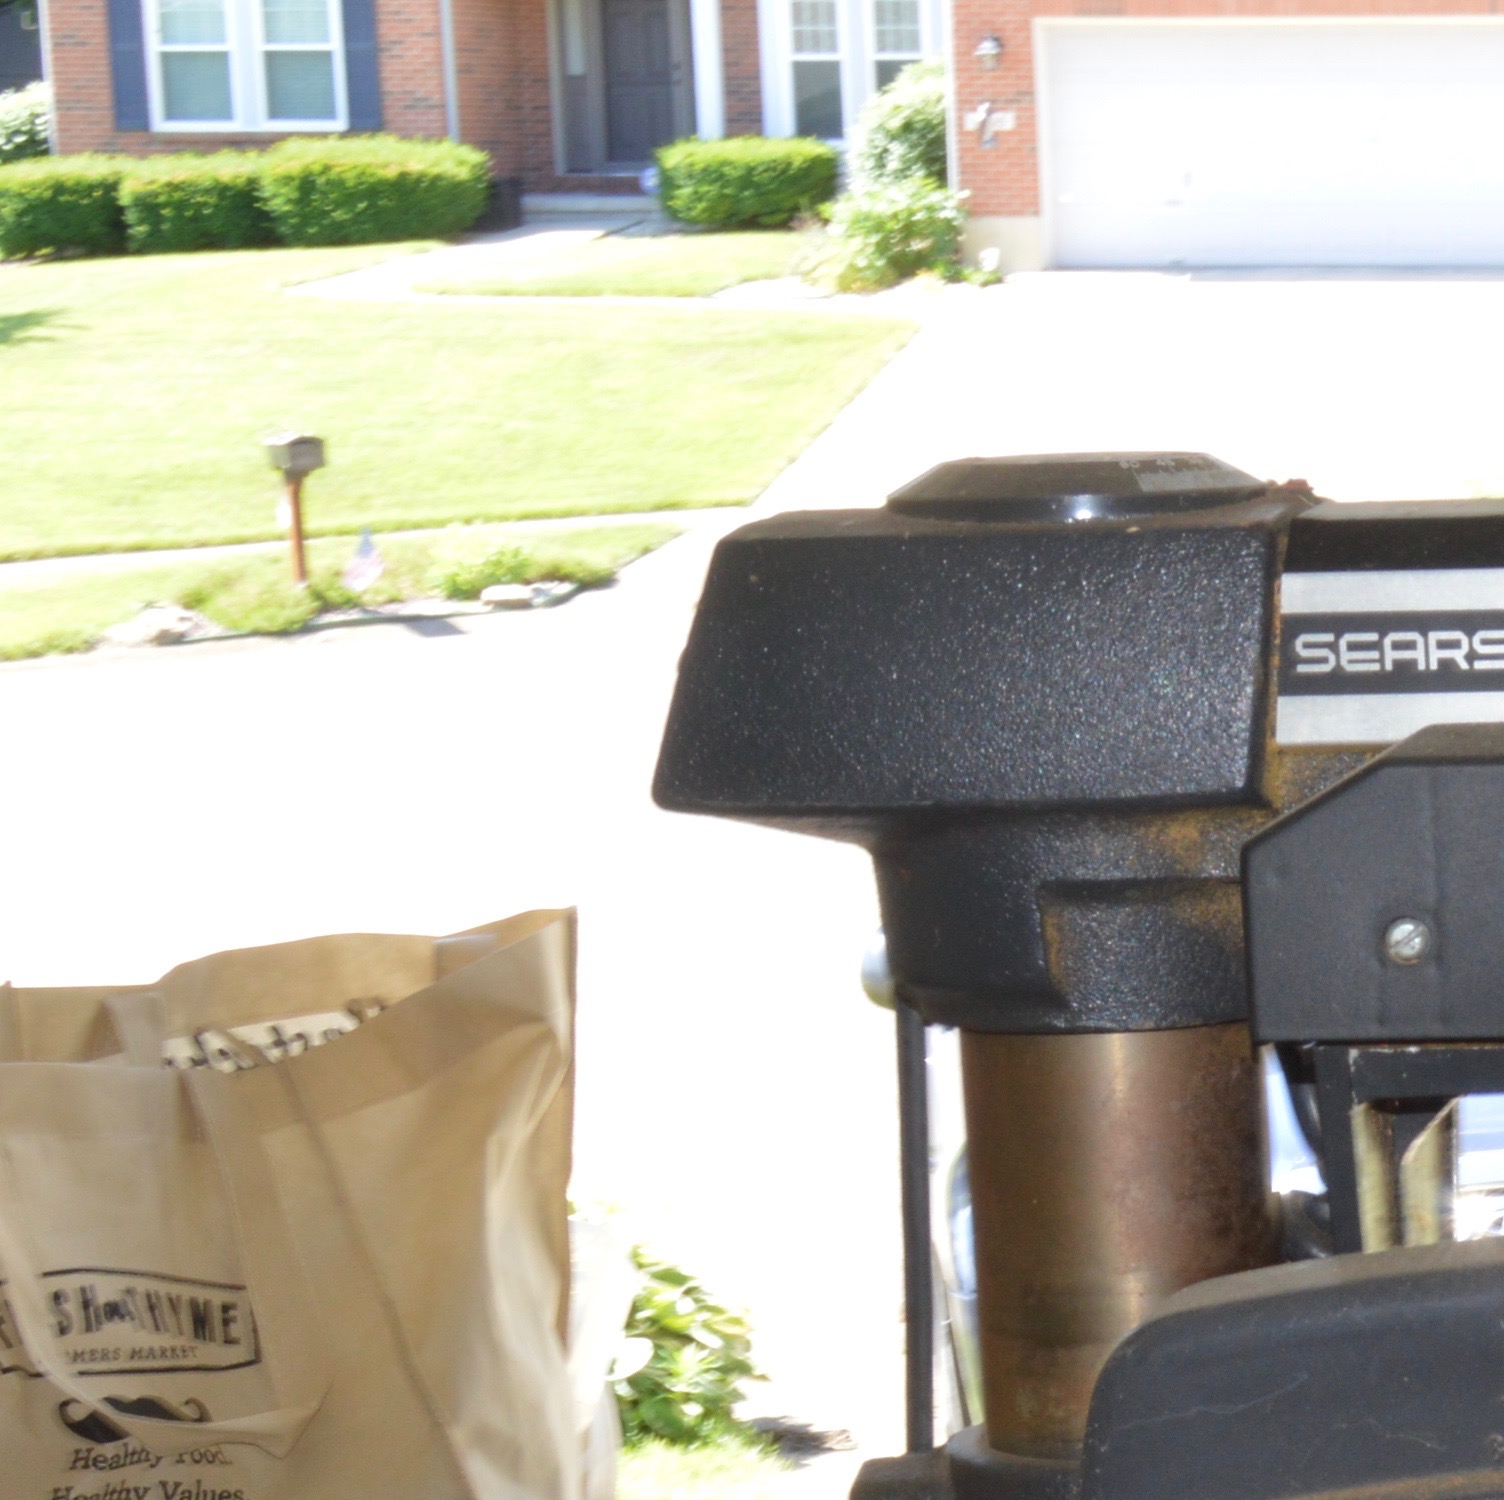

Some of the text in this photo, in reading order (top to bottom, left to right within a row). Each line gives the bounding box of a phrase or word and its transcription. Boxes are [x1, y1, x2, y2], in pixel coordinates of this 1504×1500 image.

[66, 1345, 198, 1364] MERS MARKET
[69, 1442, 164, 1471] Healthy
